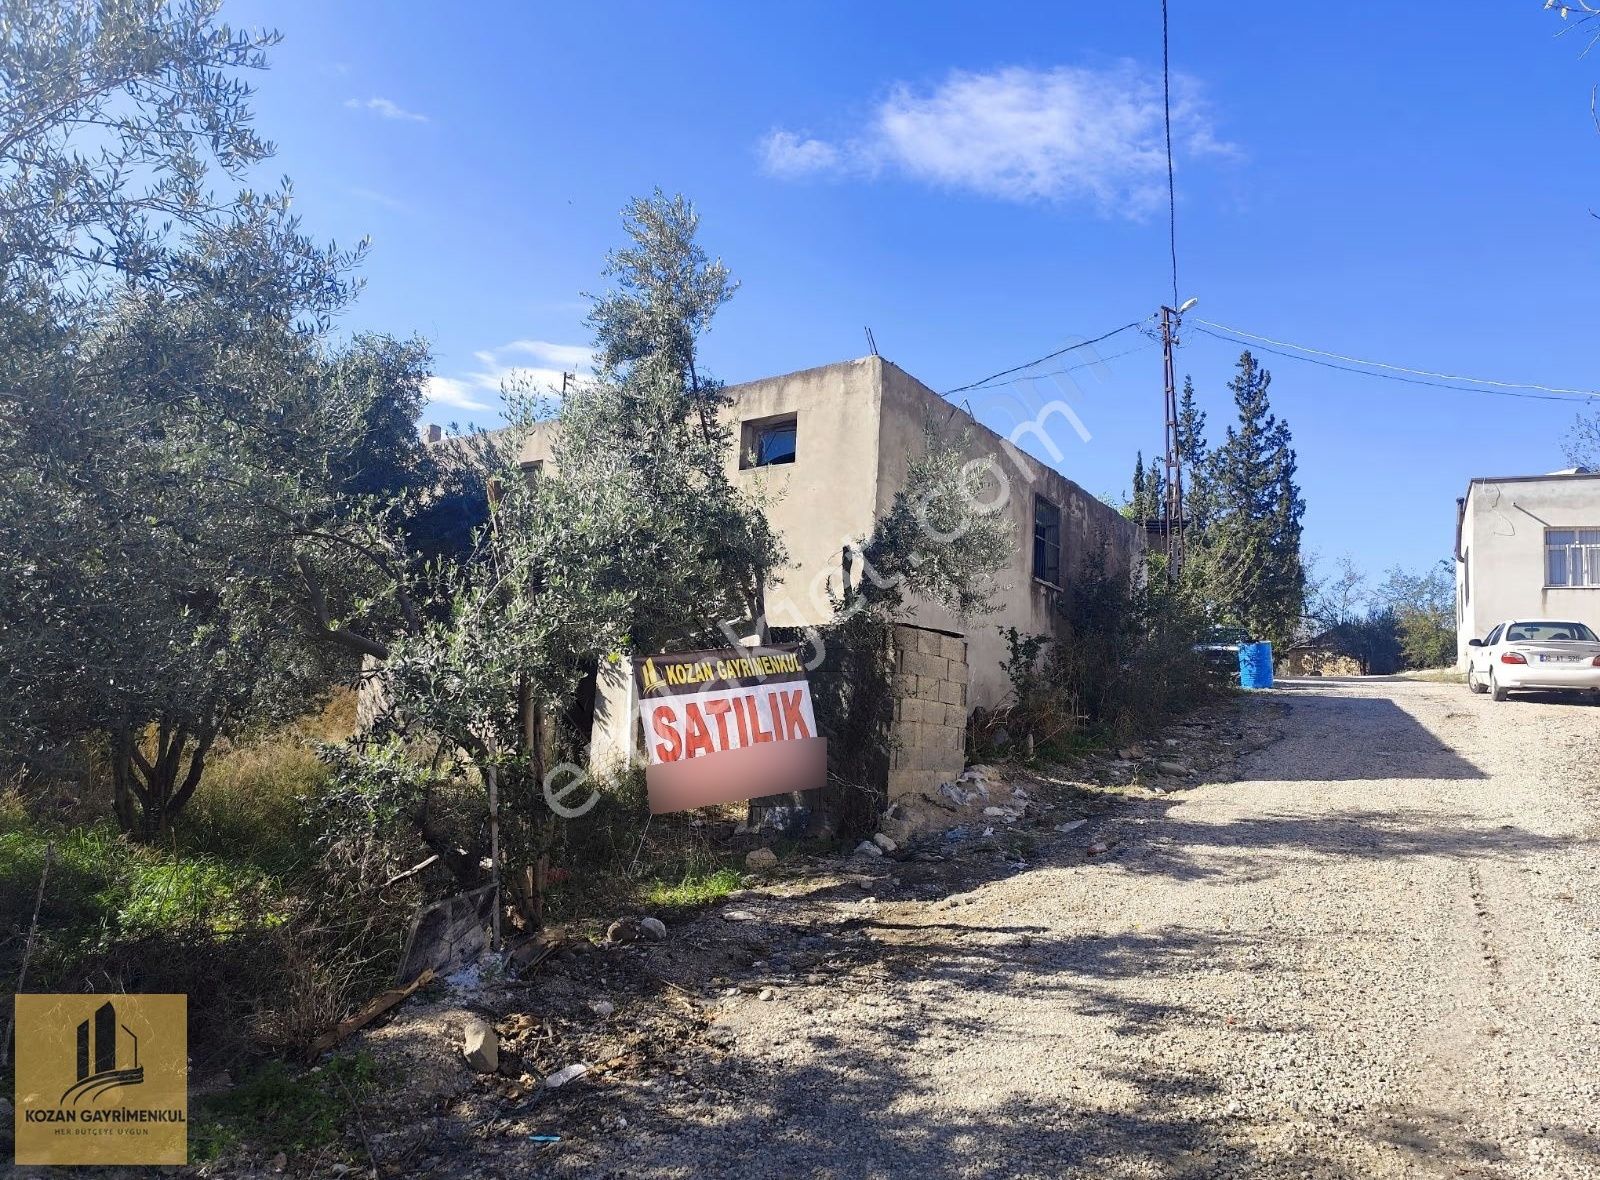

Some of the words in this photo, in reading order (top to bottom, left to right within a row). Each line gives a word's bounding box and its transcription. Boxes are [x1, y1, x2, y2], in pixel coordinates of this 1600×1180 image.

[666, 660, 713, 686] KOZAN
[718, 652, 803, 679] GAYRİMENKUL
[653, 690, 810, 763] SATILIK
